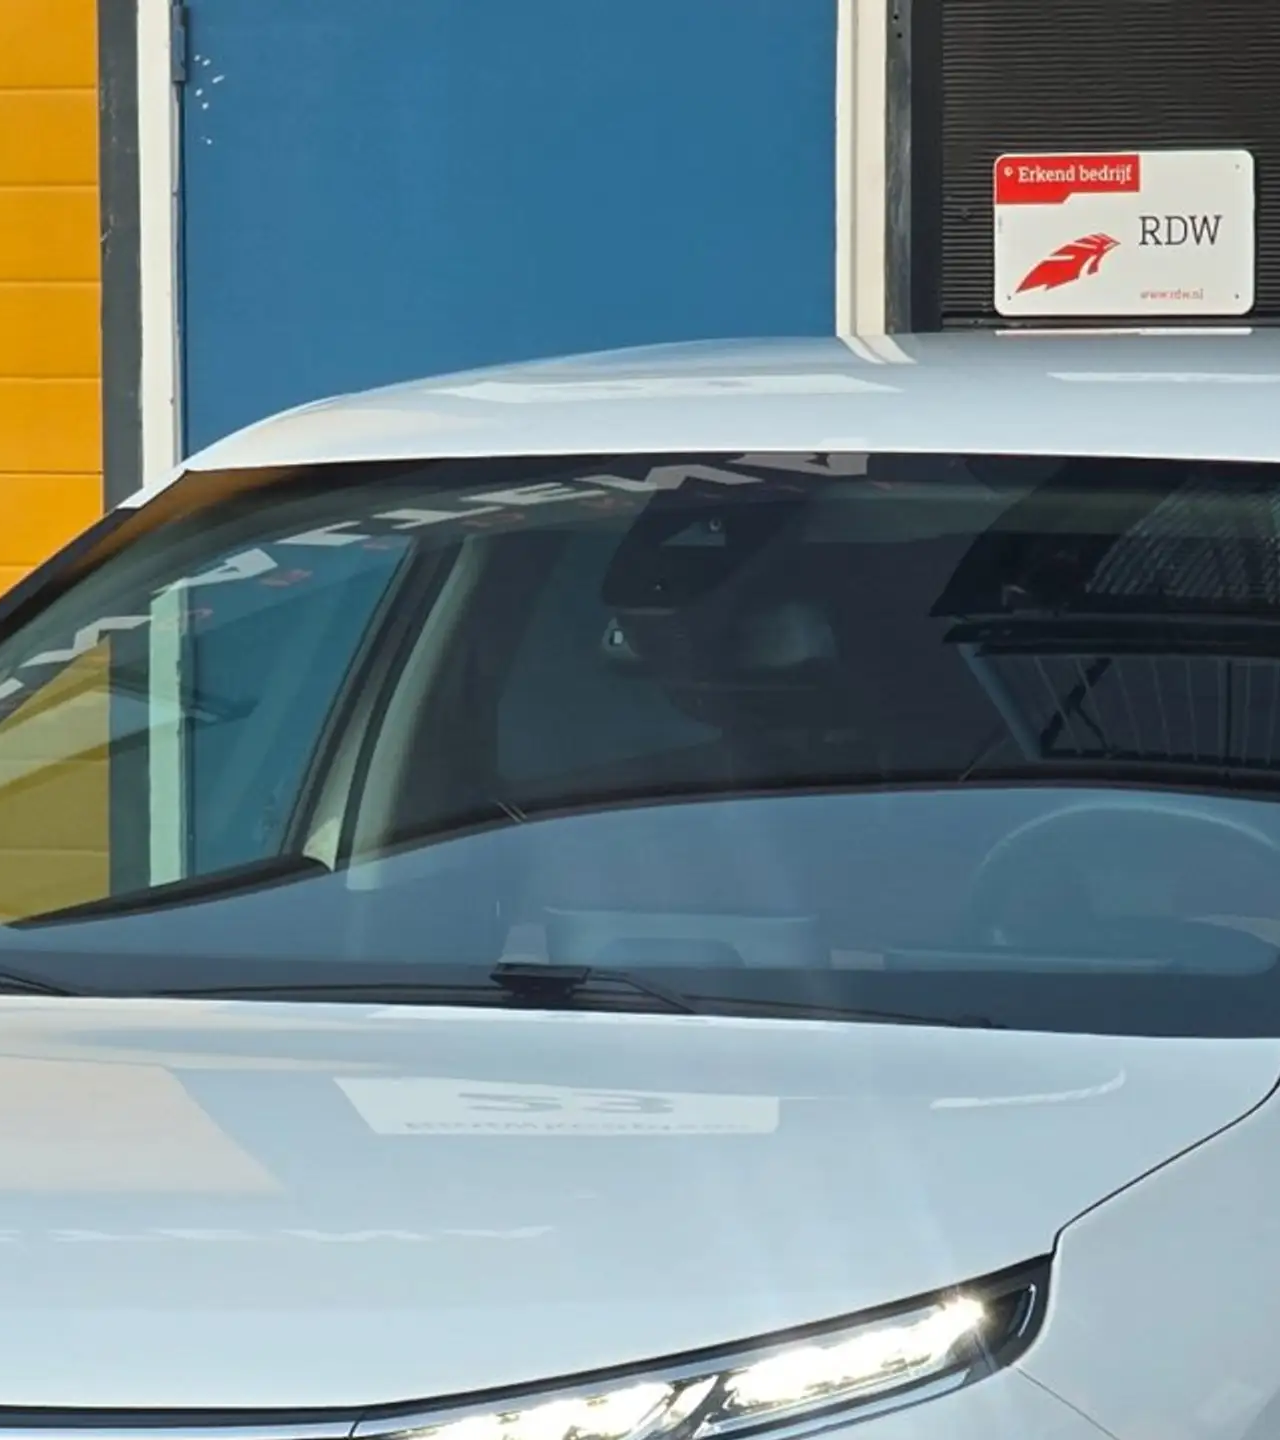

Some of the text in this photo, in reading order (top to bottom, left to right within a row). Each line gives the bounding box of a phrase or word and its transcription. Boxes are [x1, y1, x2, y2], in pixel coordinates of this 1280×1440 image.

[1018, 164, 1133, 185] Erkend bedrijf
[1138, 214, 1223, 246] RDW
[1140, 288, 1204, 301] www.rdw.nl
